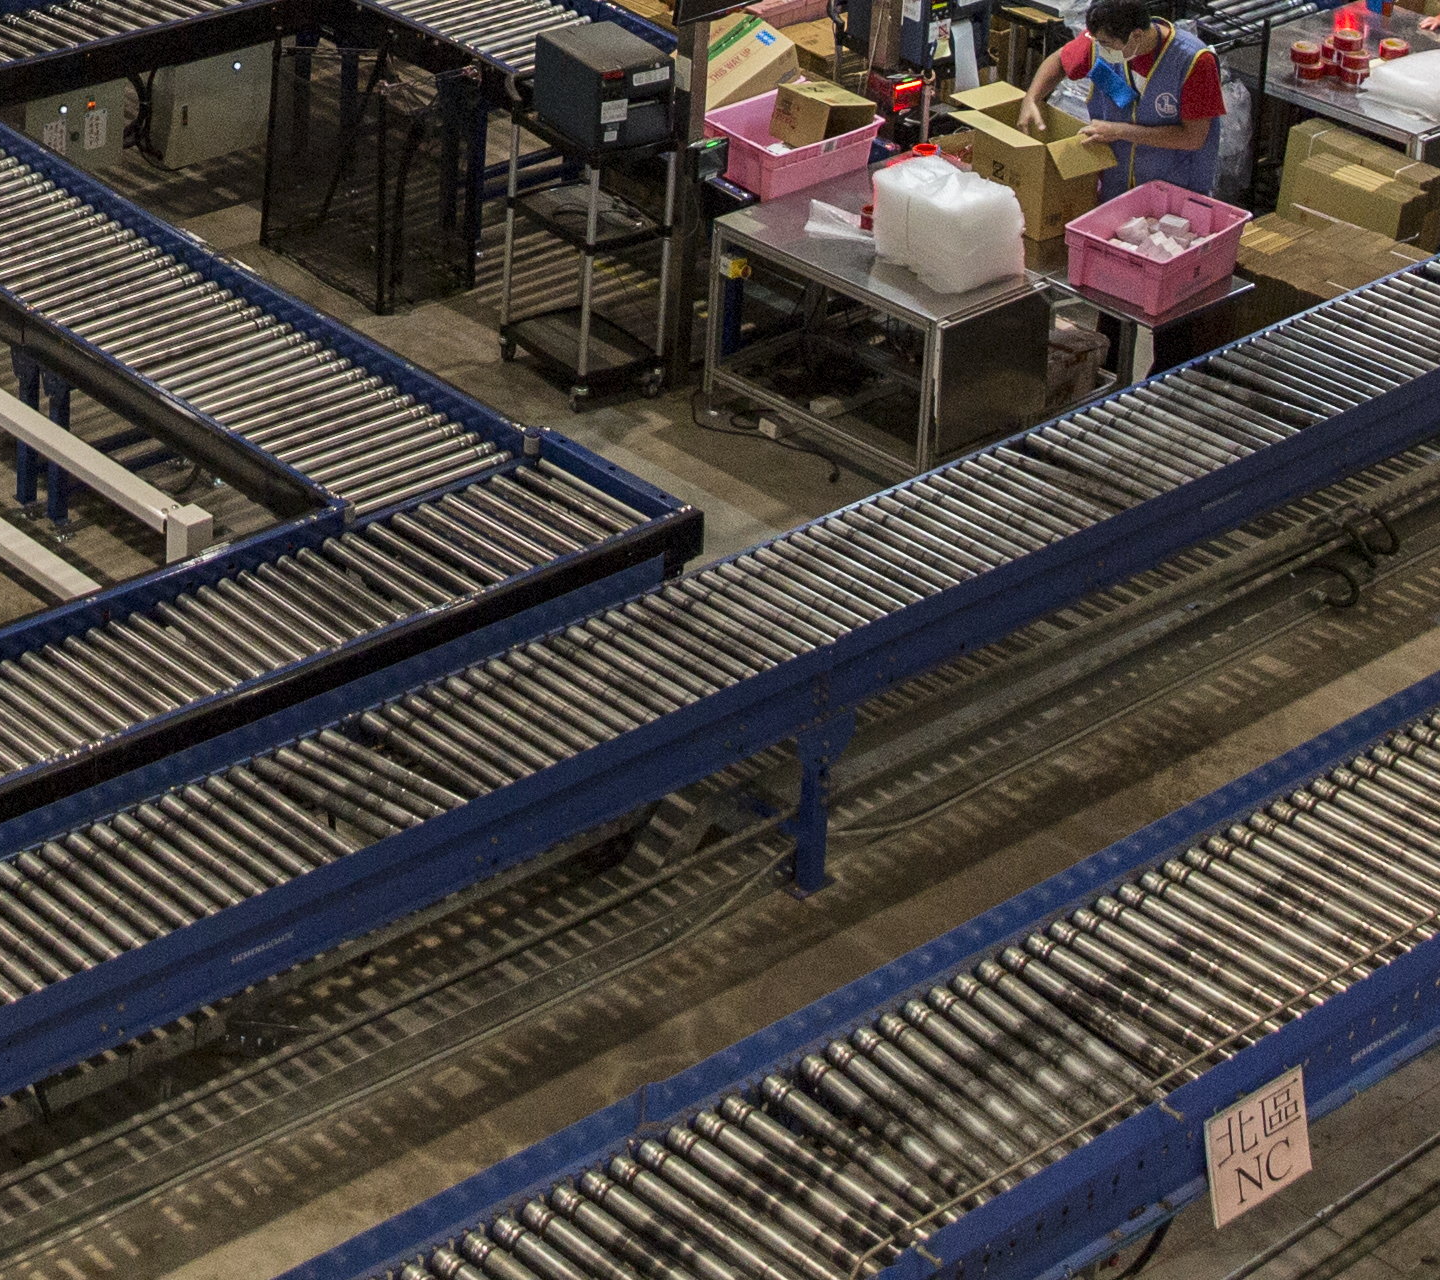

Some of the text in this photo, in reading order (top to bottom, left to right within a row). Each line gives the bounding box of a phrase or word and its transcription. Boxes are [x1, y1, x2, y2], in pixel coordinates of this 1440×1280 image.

[709, 47, 752, 82] THIS WAY UP
[1216, 1077, 1302, 1170] 北區
[1235, 1138, 1294, 1205] NC
